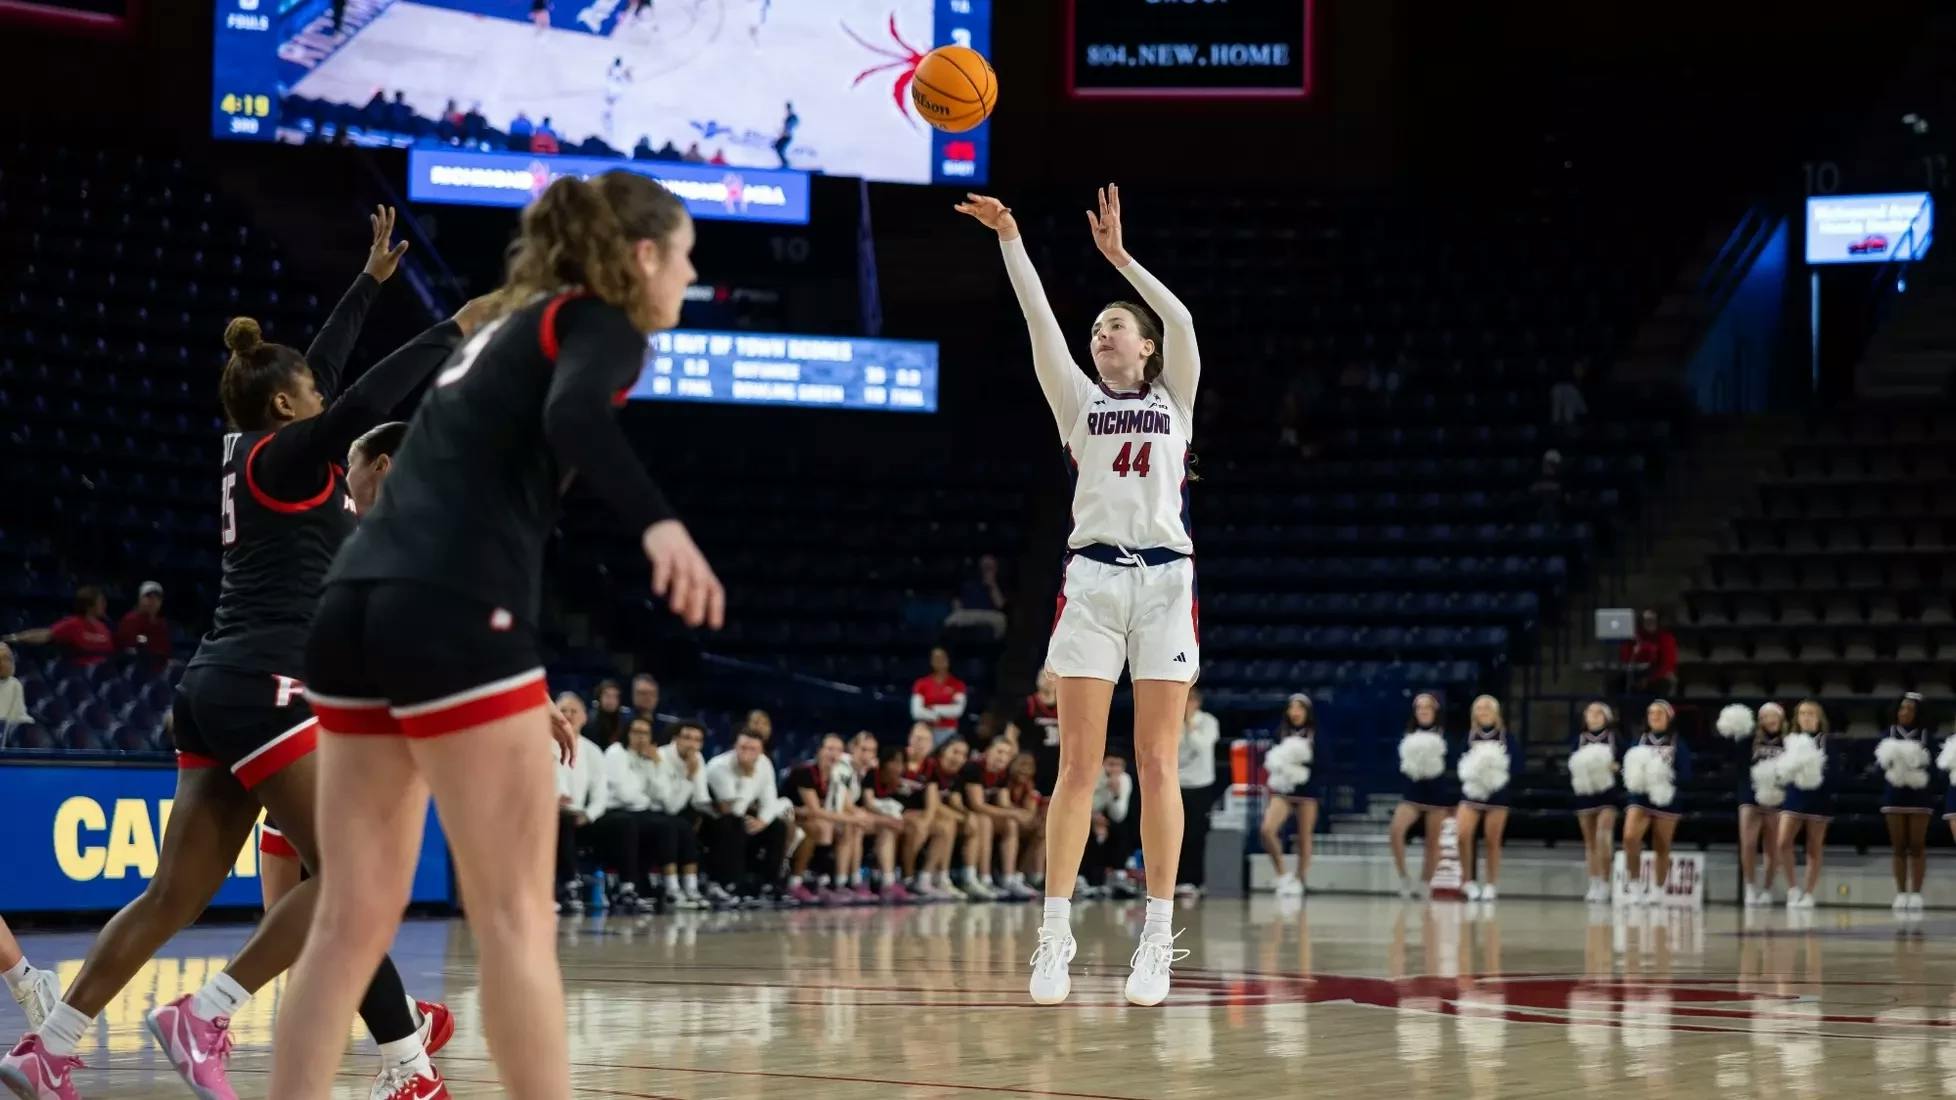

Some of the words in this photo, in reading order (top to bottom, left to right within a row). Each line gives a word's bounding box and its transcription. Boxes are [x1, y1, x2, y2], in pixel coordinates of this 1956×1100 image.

[227, 13, 269, 31] FOULS
[1087, 43, 1290, 66] 804.NEW.HOME
[220, 93, 270, 117] 4:19
[673, 334, 708, 354] OUT
[710, 335, 733, 355] OF
[735, 337, 786, 358] TOWN
[797, 384, 844, 402] GREEN
[1087, 409, 1171, 436] RICHMOND
[1112, 441, 1152, 477] 44
